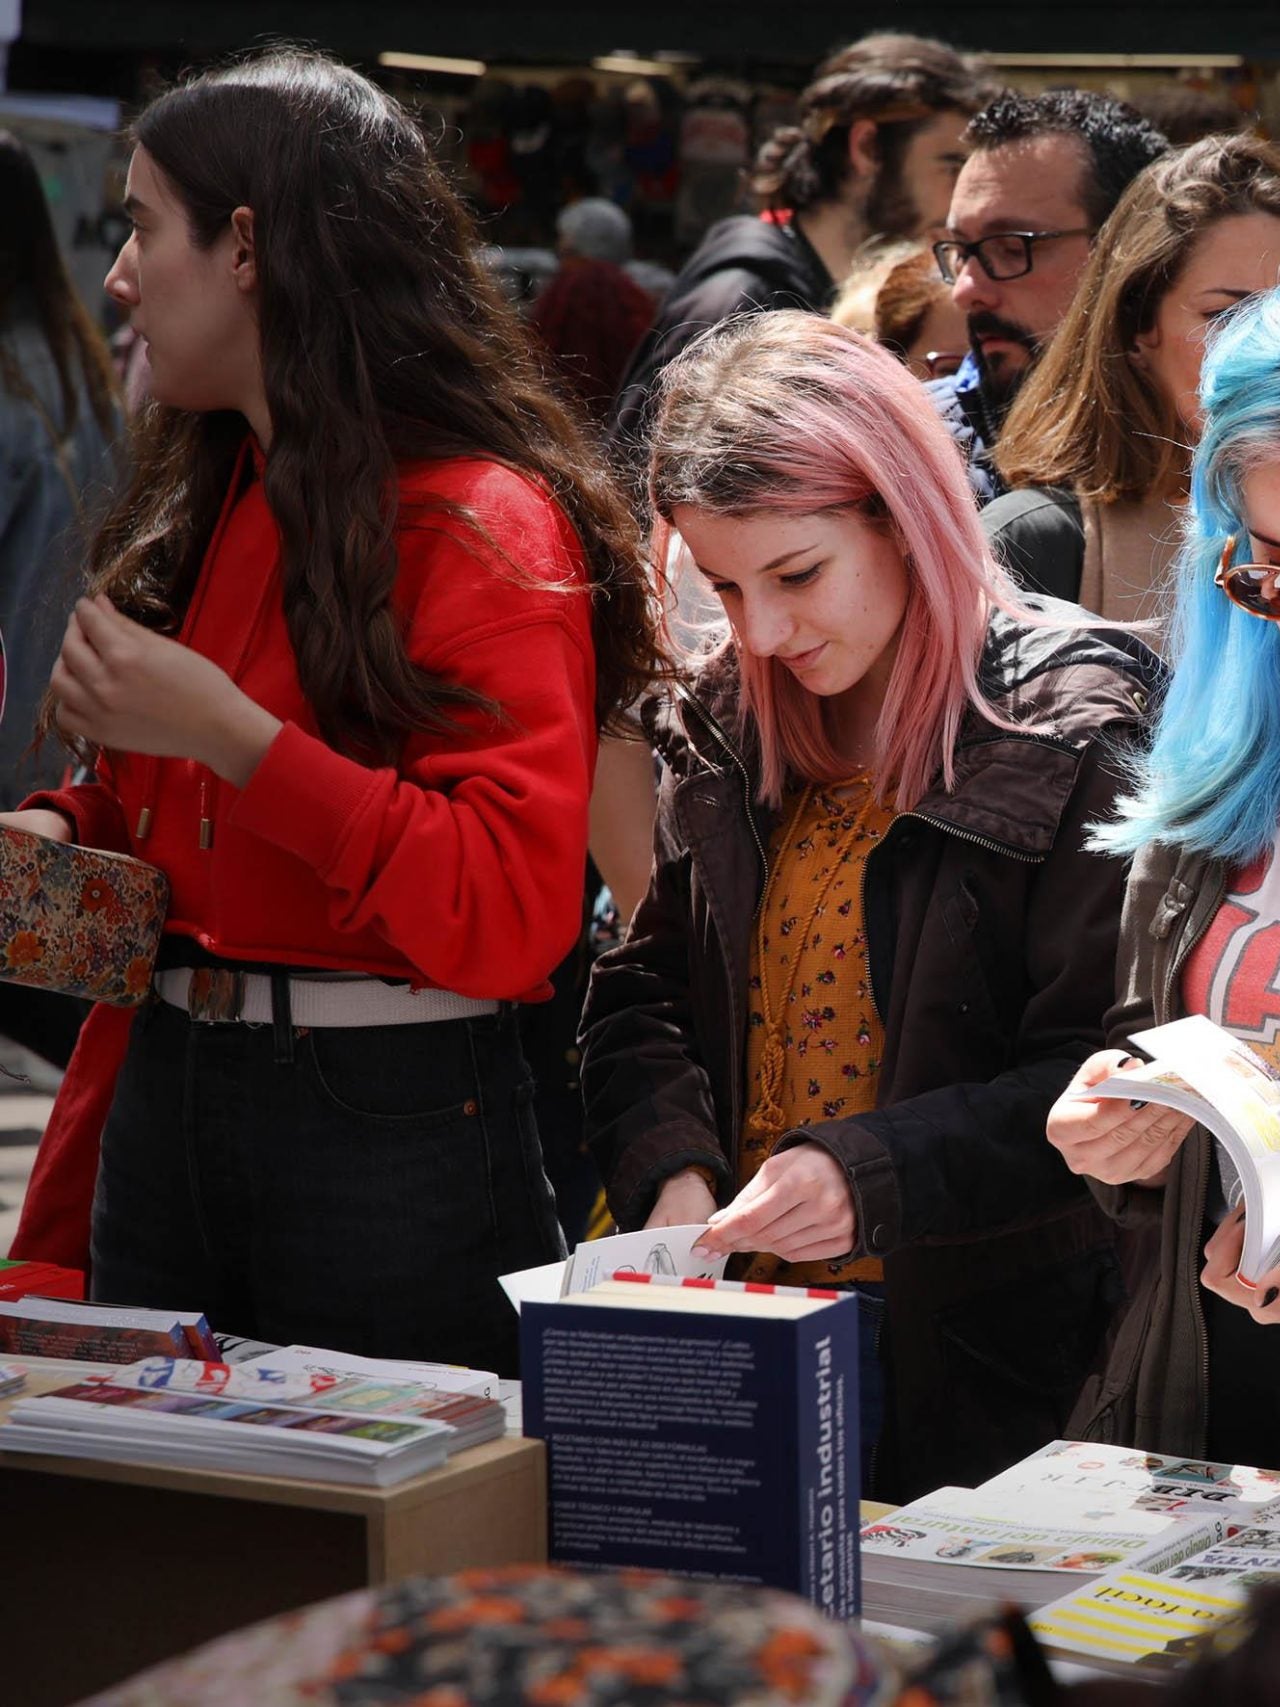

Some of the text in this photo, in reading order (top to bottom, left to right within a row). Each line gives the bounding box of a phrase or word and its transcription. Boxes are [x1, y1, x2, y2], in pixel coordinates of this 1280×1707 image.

[814, 1335, 834, 1497] industrial
[835, 1428, 845, 1451] los
[835, 1454, 845, 1495] todos
[837, 1498, 848, 1529] para
[888, 1514, 1001, 1538] natural
[1003, 1530, 1049, 1544] del
[1053, 1534, 1148, 1551] Dibujo
[1093, 1586, 1181, 1616] fácil
